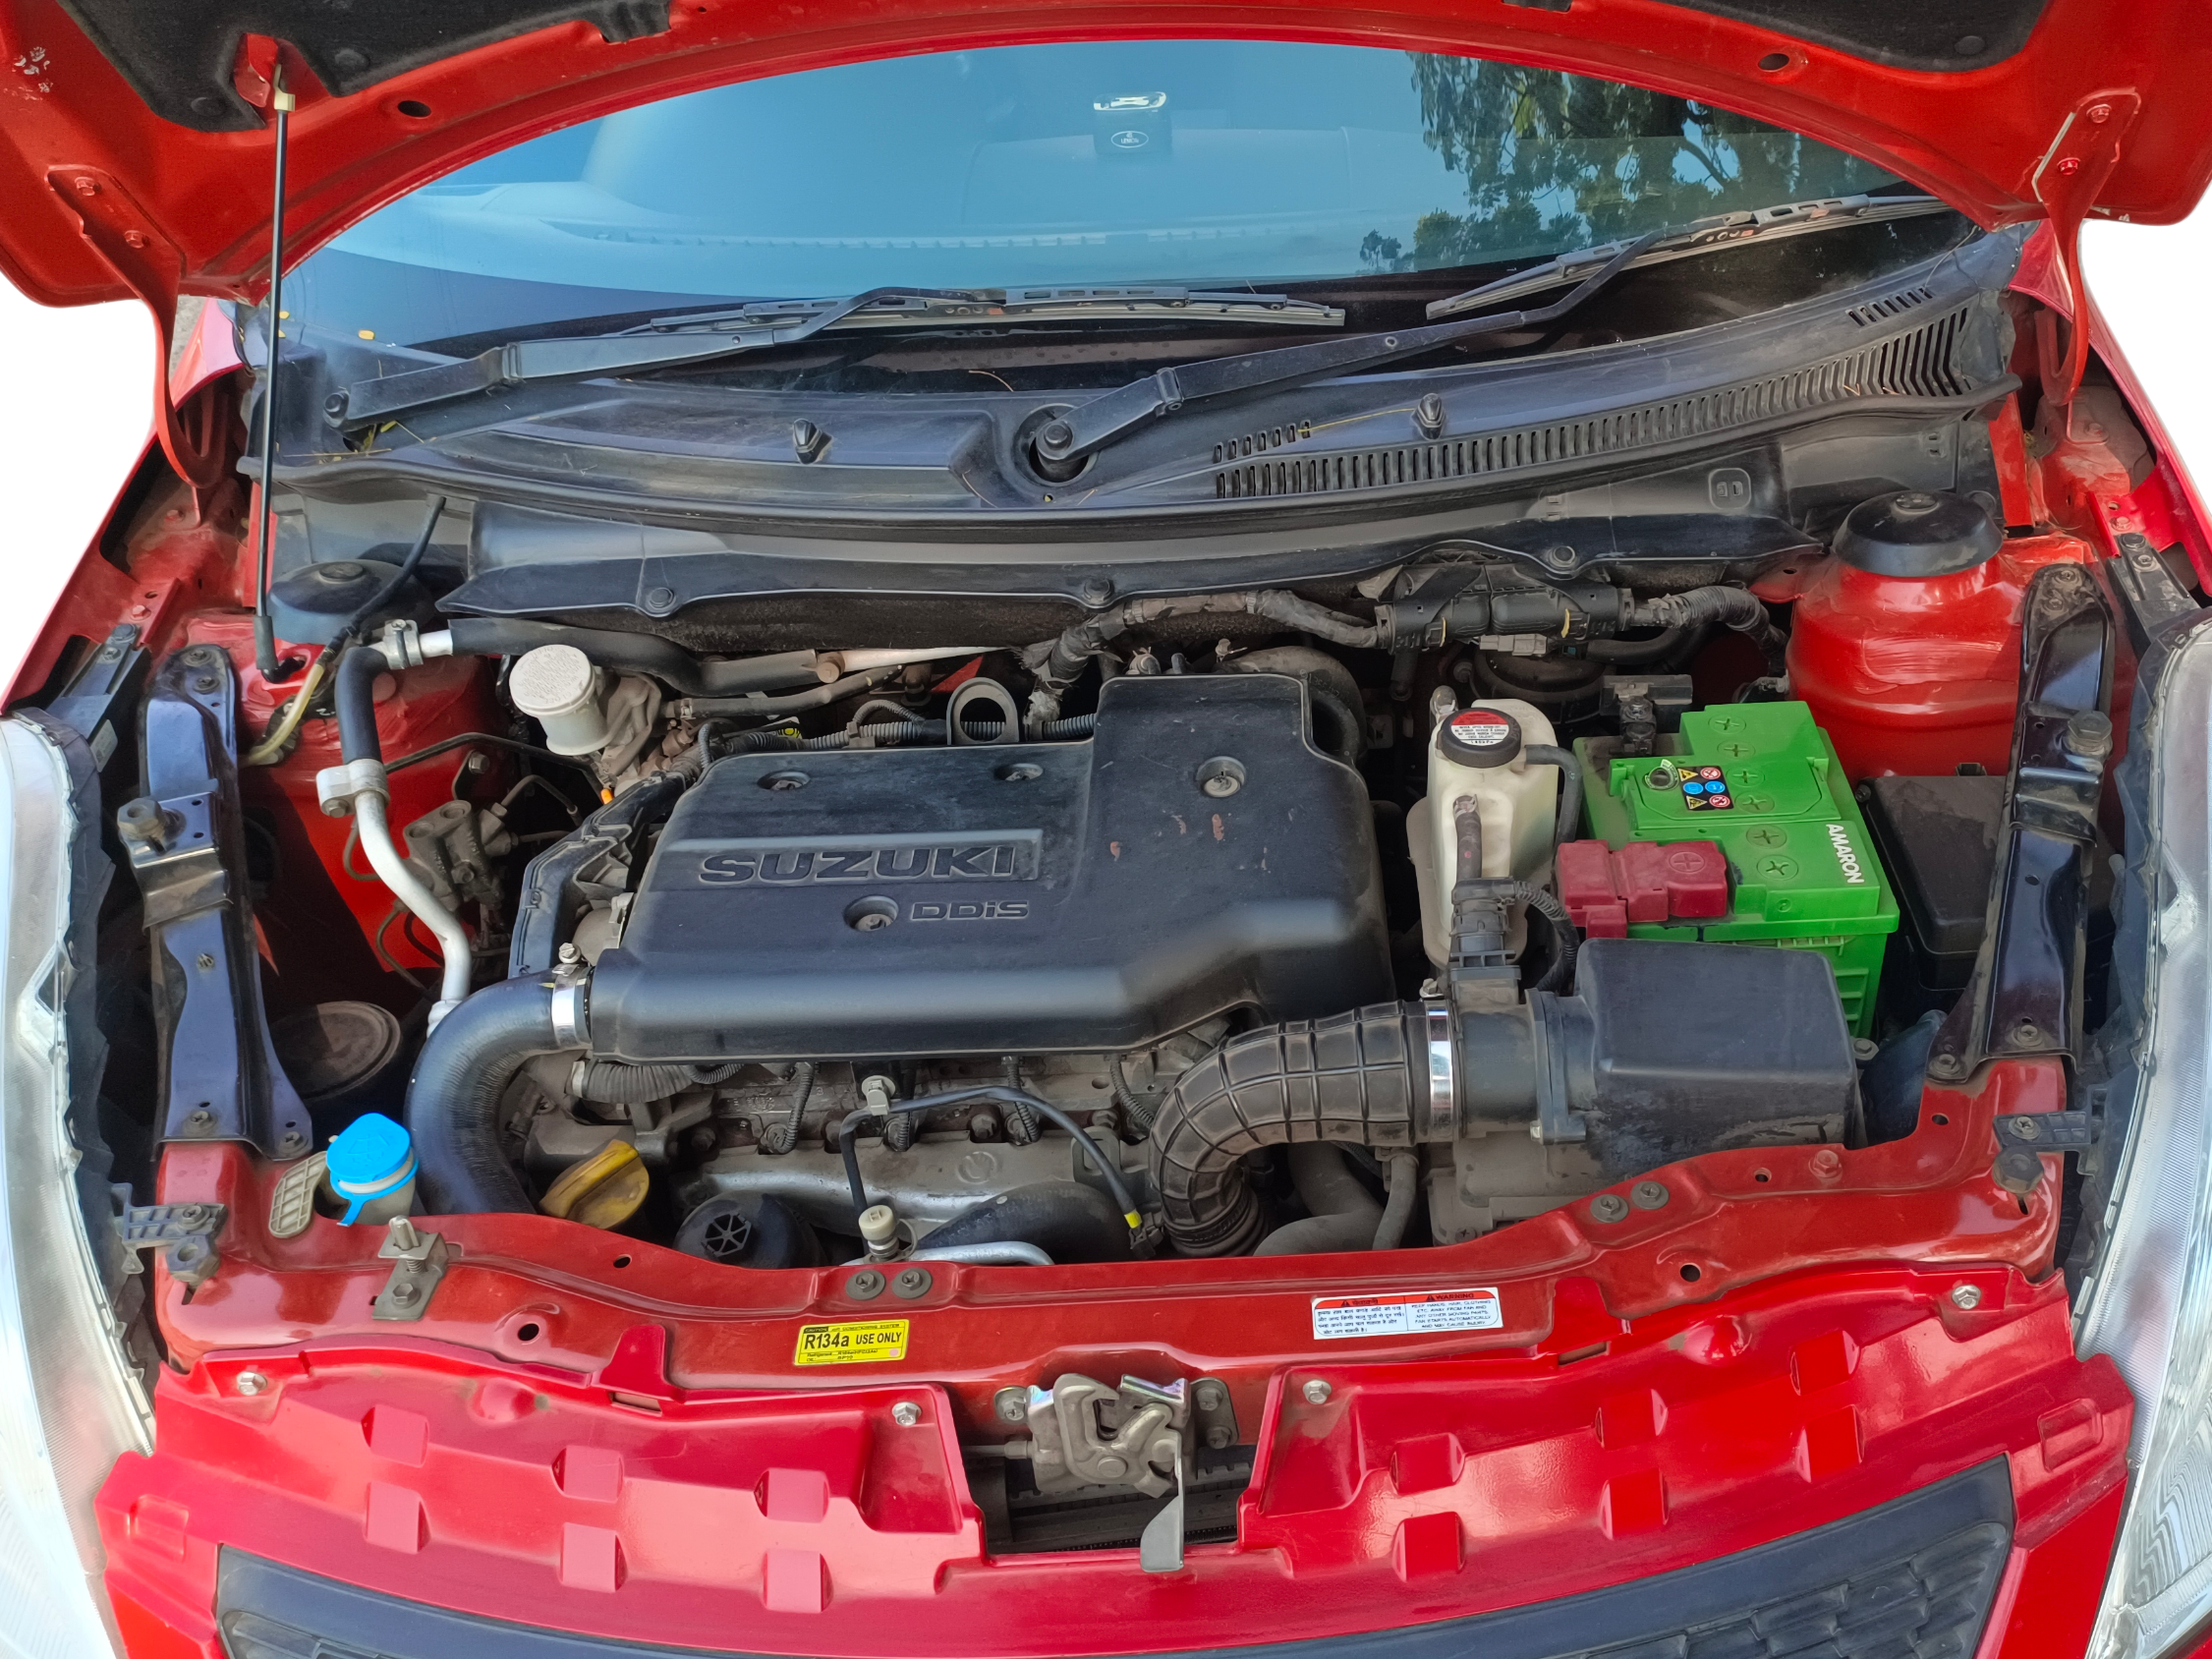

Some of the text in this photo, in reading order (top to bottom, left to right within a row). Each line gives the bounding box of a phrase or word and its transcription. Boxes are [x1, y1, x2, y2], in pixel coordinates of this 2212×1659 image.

[699, 846, 1015, 884] SUZUKI
[1826, 824, 1864, 884] AMARON
[911, 900, 1028, 921] DDiS
[805, 1332, 902, 1349] R134a USE ONLY
